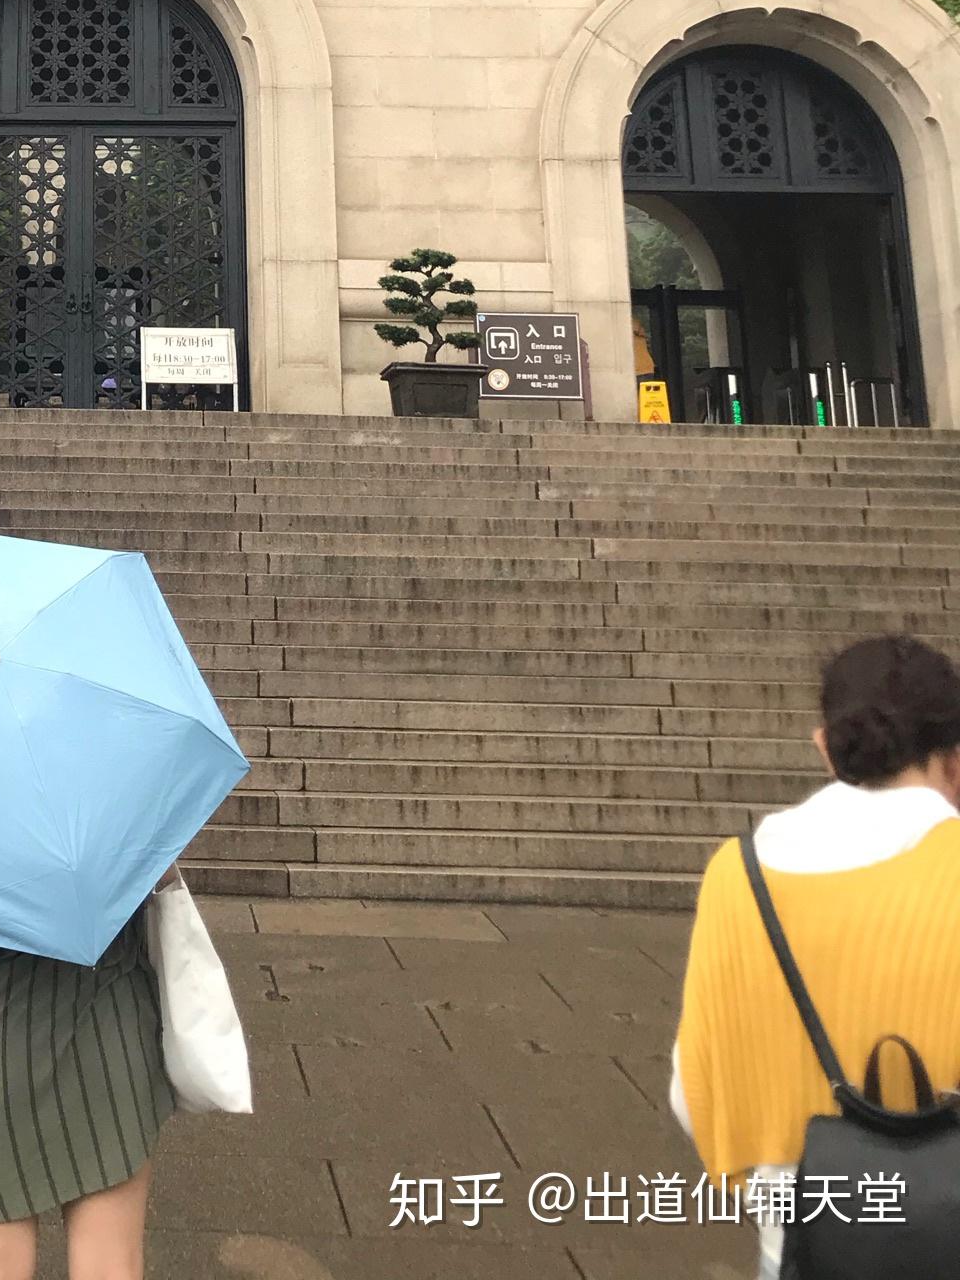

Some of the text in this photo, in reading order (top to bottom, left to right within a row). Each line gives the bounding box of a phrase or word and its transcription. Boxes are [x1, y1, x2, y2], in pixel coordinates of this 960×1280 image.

[525, 323, 566, 338] 入口
[164, 336, 214, 348] 开放时间
[530, 342, 563, 350] Entrance
[524, 354, 572, 365] 入口 입구
